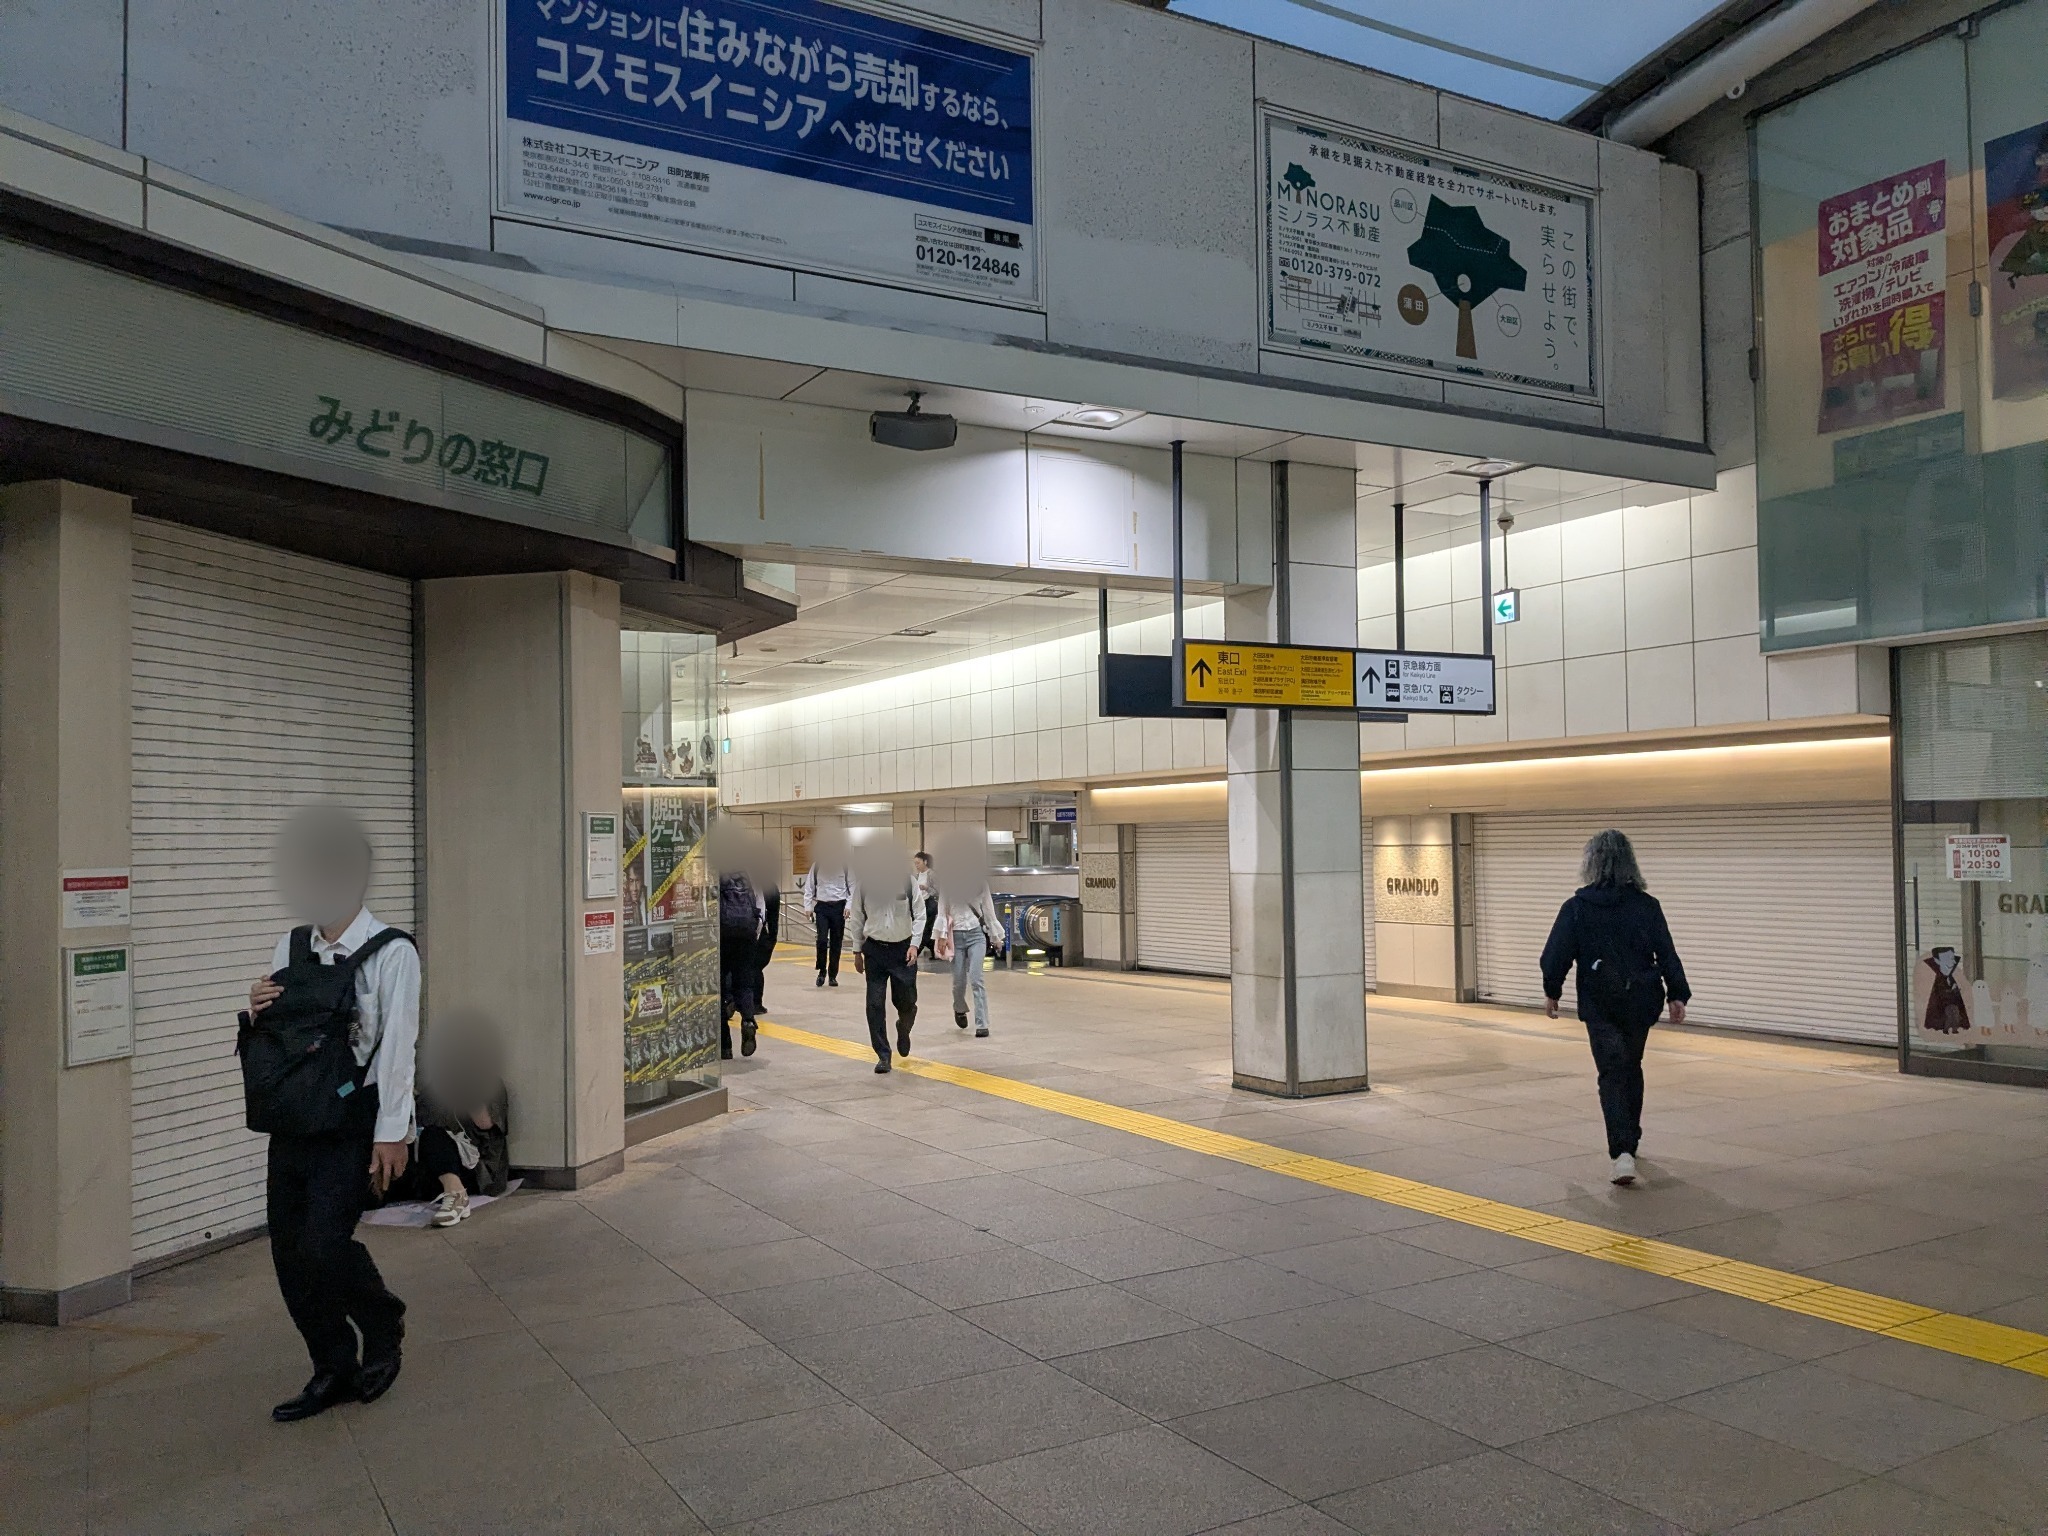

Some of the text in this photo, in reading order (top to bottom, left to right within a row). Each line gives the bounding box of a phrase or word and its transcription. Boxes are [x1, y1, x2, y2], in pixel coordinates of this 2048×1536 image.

[522, 136, 660, 172] 株式会社コスモスイニシア
[1277, 203, 1381, 243] ミノラス不動産
[1830, 206, 1914, 268] 対象品
[915, 244, 1020, 279] 0120-124846
[1291, 257, 1381, 288] 0120-379-072
[1541, 225, 1559, 371] 実らせよう。
[1562, 231, 1579, 348] この街で、
[308, 394, 550, 496] みどりの窓口
[1217, 650, 1241, 667] 東口
[1402, 660, 1442, 672] 京急線方面
[1217, 667, 1233, 676] East
[1234, 667, 1247, 678] Exit
[1402, 683, 1434, 694] 京急バス
[1456, 686, 1484, 696] タクシー
[651, 797, 683, 822] 脱出
[651, 820, 685, 844] ゲーム
[1966, 860, 2001, 869] 20:30
[1967, 849, 2001, 858] 10:00
[1085, 877, 1116, 889] GRANDUO
[1386, 877, 1439, 894] GRANDUO
[1997, 893, 2048, 915] GRA
